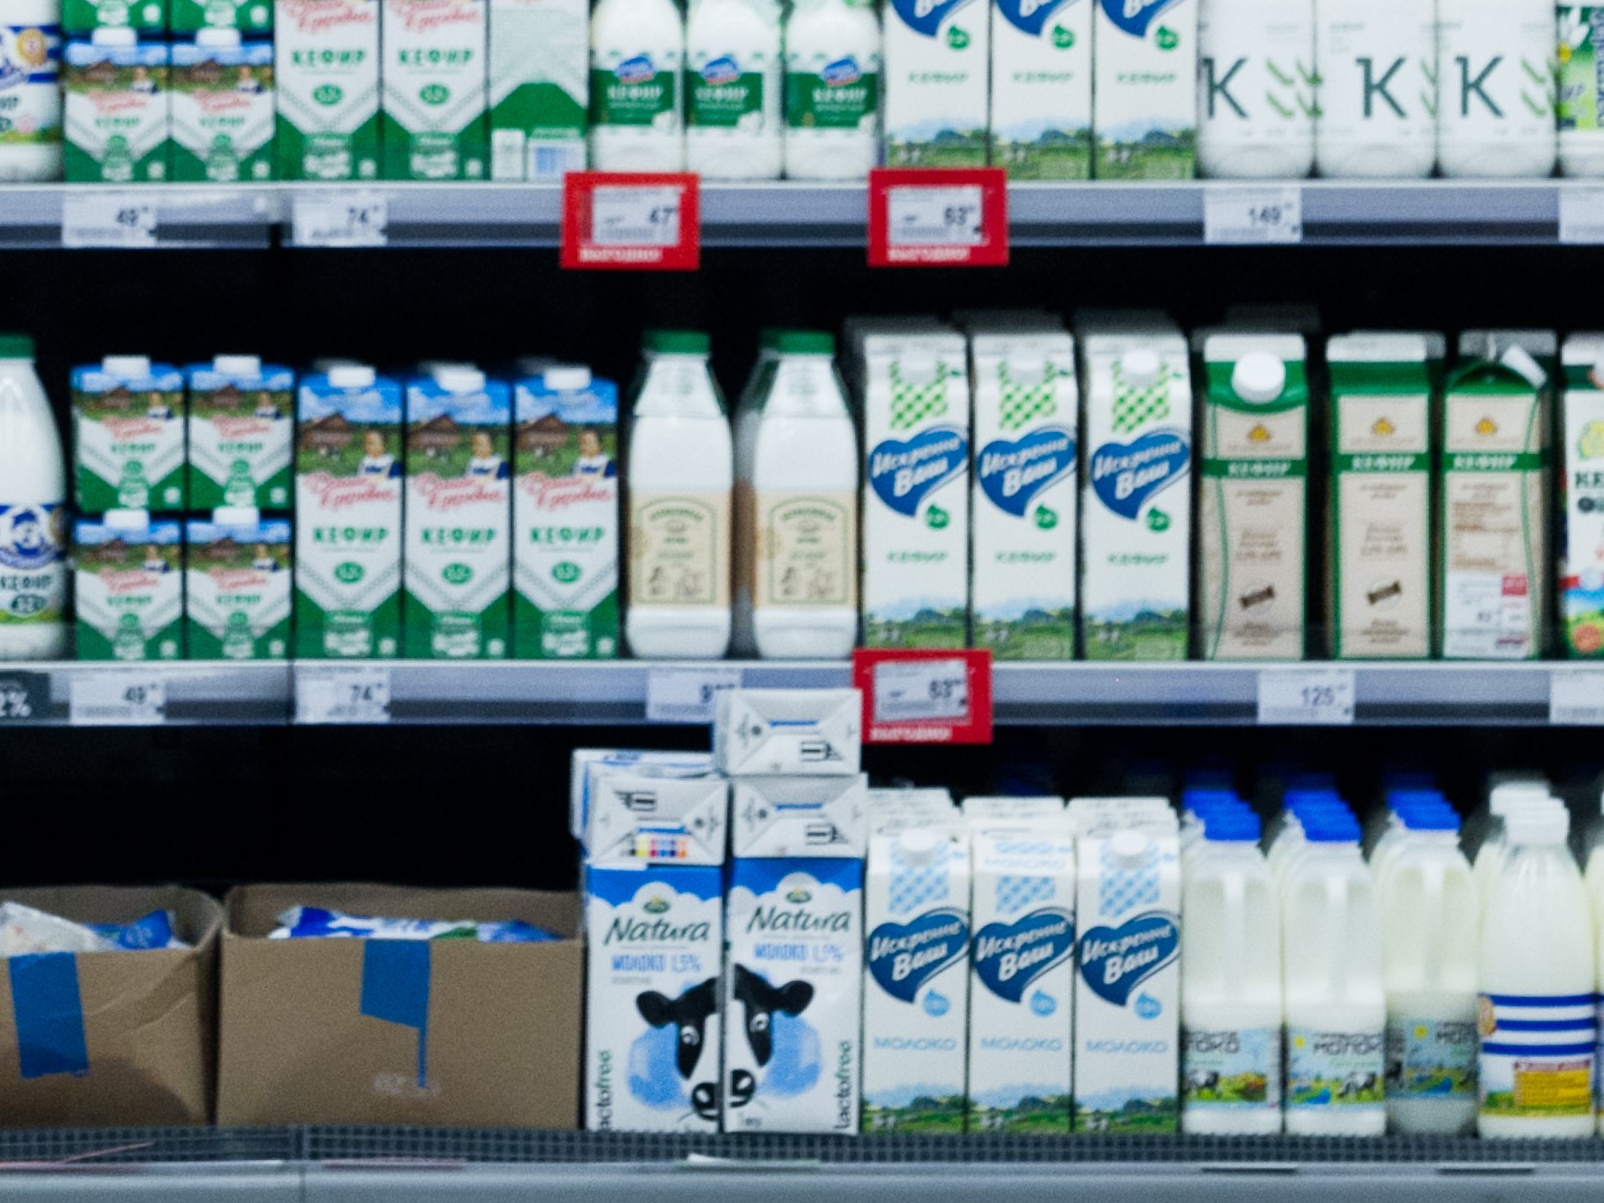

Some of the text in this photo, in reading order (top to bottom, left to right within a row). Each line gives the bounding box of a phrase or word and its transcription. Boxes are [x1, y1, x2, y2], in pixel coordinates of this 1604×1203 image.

[894, 458, 948, 498] Ваш
[1002, 458, 1057, 498] Ваш
[1116, 461, 1171, 501] Ваш
[312, 527, 388, 543] КЕФИР
[420, 528, 497, 544] КЕФИР
[528, 526, 605, 543] КЕФИР
[604, 917, 711, 945] Natura
[746, 907, 852, 933] Natura
[870, 920, 960, 962] Искренне
[977, 920, 1066, 962] Искренне
[1082, 924, 1172, 965] Искренне
[892, 942, 947, 982] Ваш
[998, 942, 1053, 982] Ваш
[1104, 946, 1159, 985] Ваш
